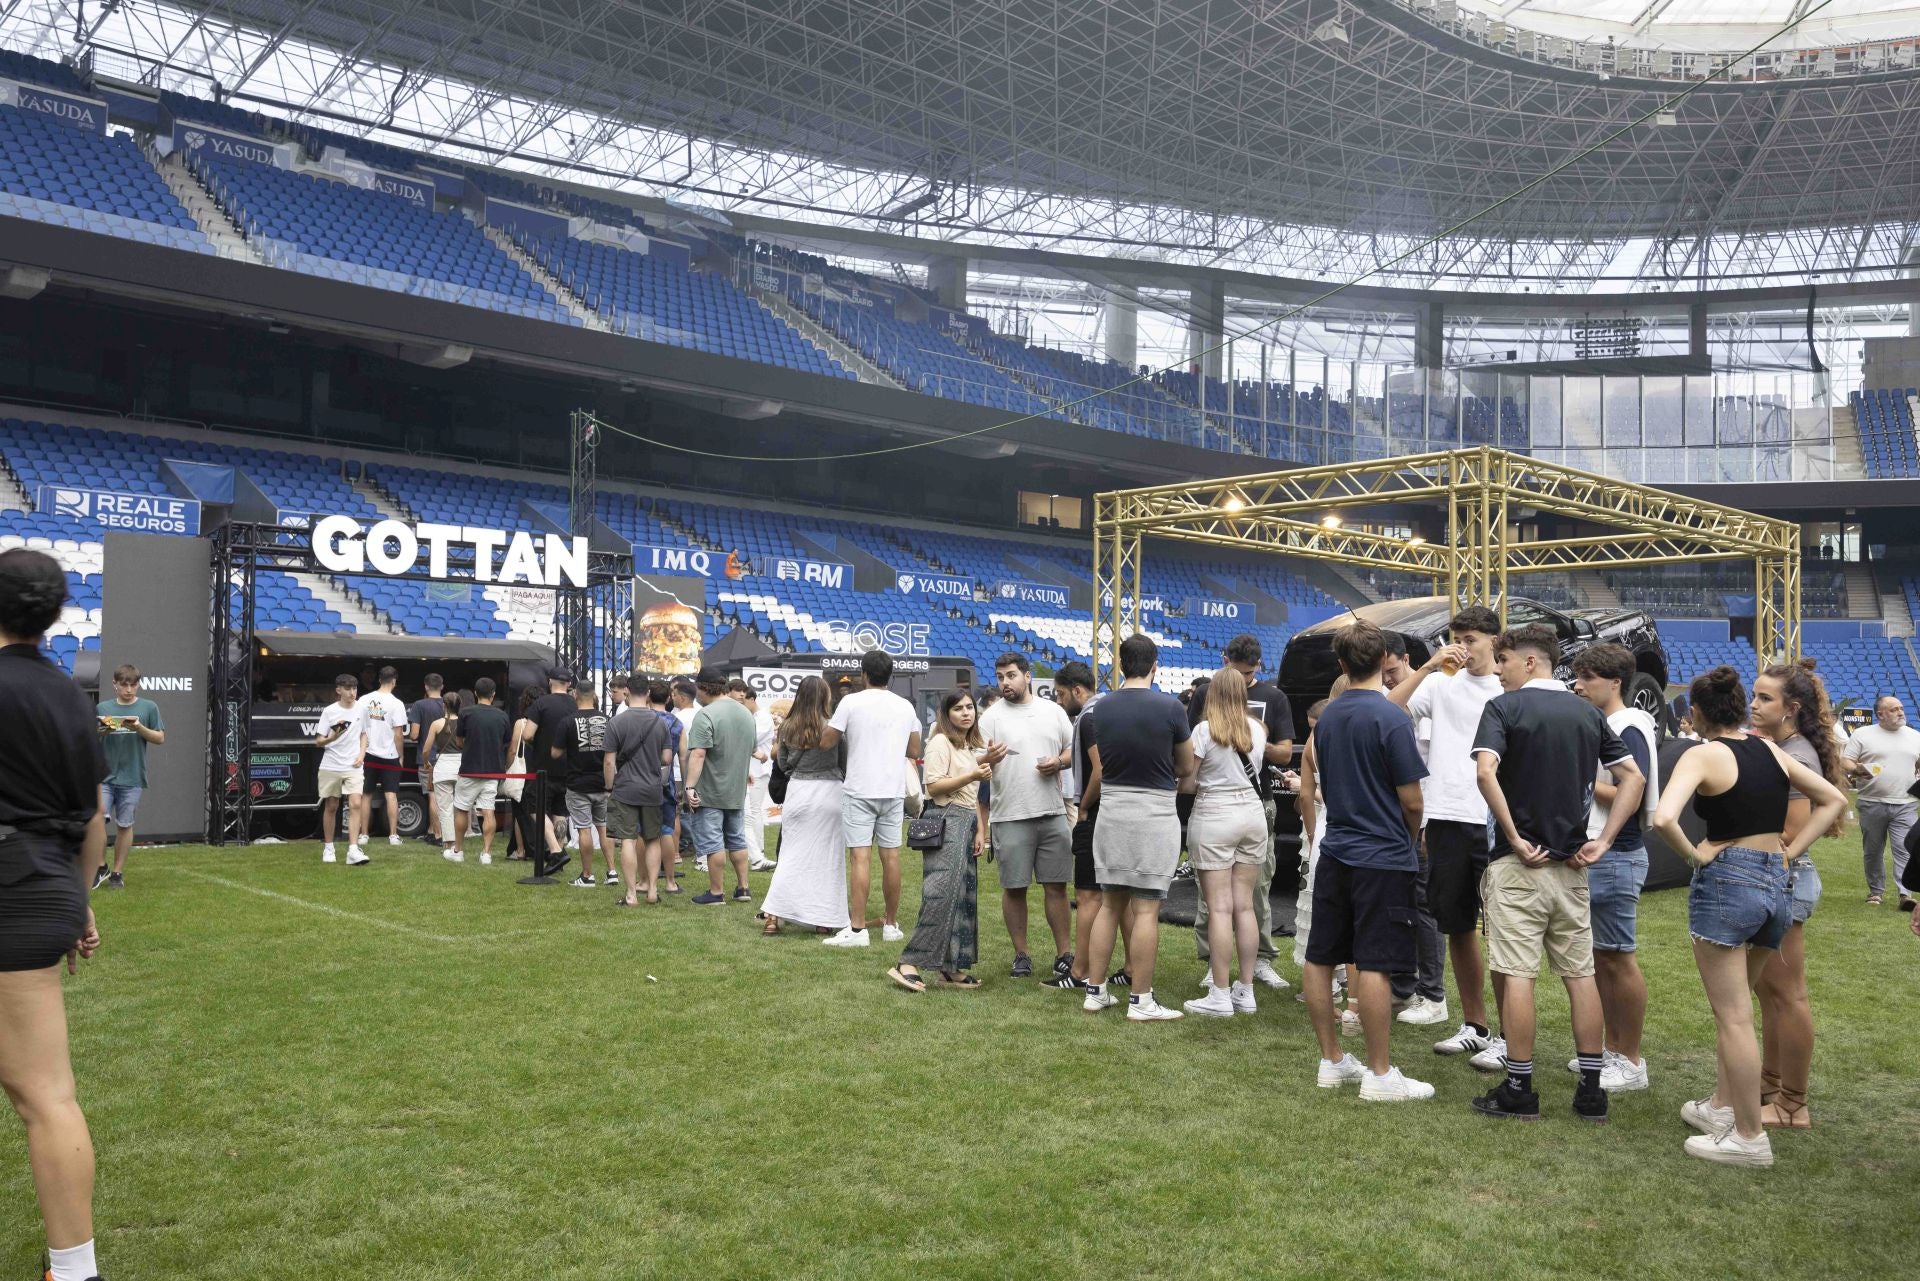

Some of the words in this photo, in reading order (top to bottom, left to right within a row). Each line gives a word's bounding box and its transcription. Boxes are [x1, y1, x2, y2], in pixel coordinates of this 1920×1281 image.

[18, 94, 95, 124] YASUDA
[211, 138, 280, 167] YASUDA
[364, 176, 425, 201] YASUDA
[97, 494, 185, 519] REALE
[97, 513, 186, 533] SEGUROS
[312, 514, 589, 588] GOTTAN
[652, 548, 712, 577] IMQ
[804, 563, 843, 589] RM
[918, 578, 971, 596] YASUDA
[1020, 587, 1067, 606] YASUDA
[1103, 592, 1164, 612] fietork
[820, 619, 930, 656] GOSE
[892, 660, 929, 670] RGERS
[747, 673, 803, 693] GOS
[575, 717, 590, 748] VANS
